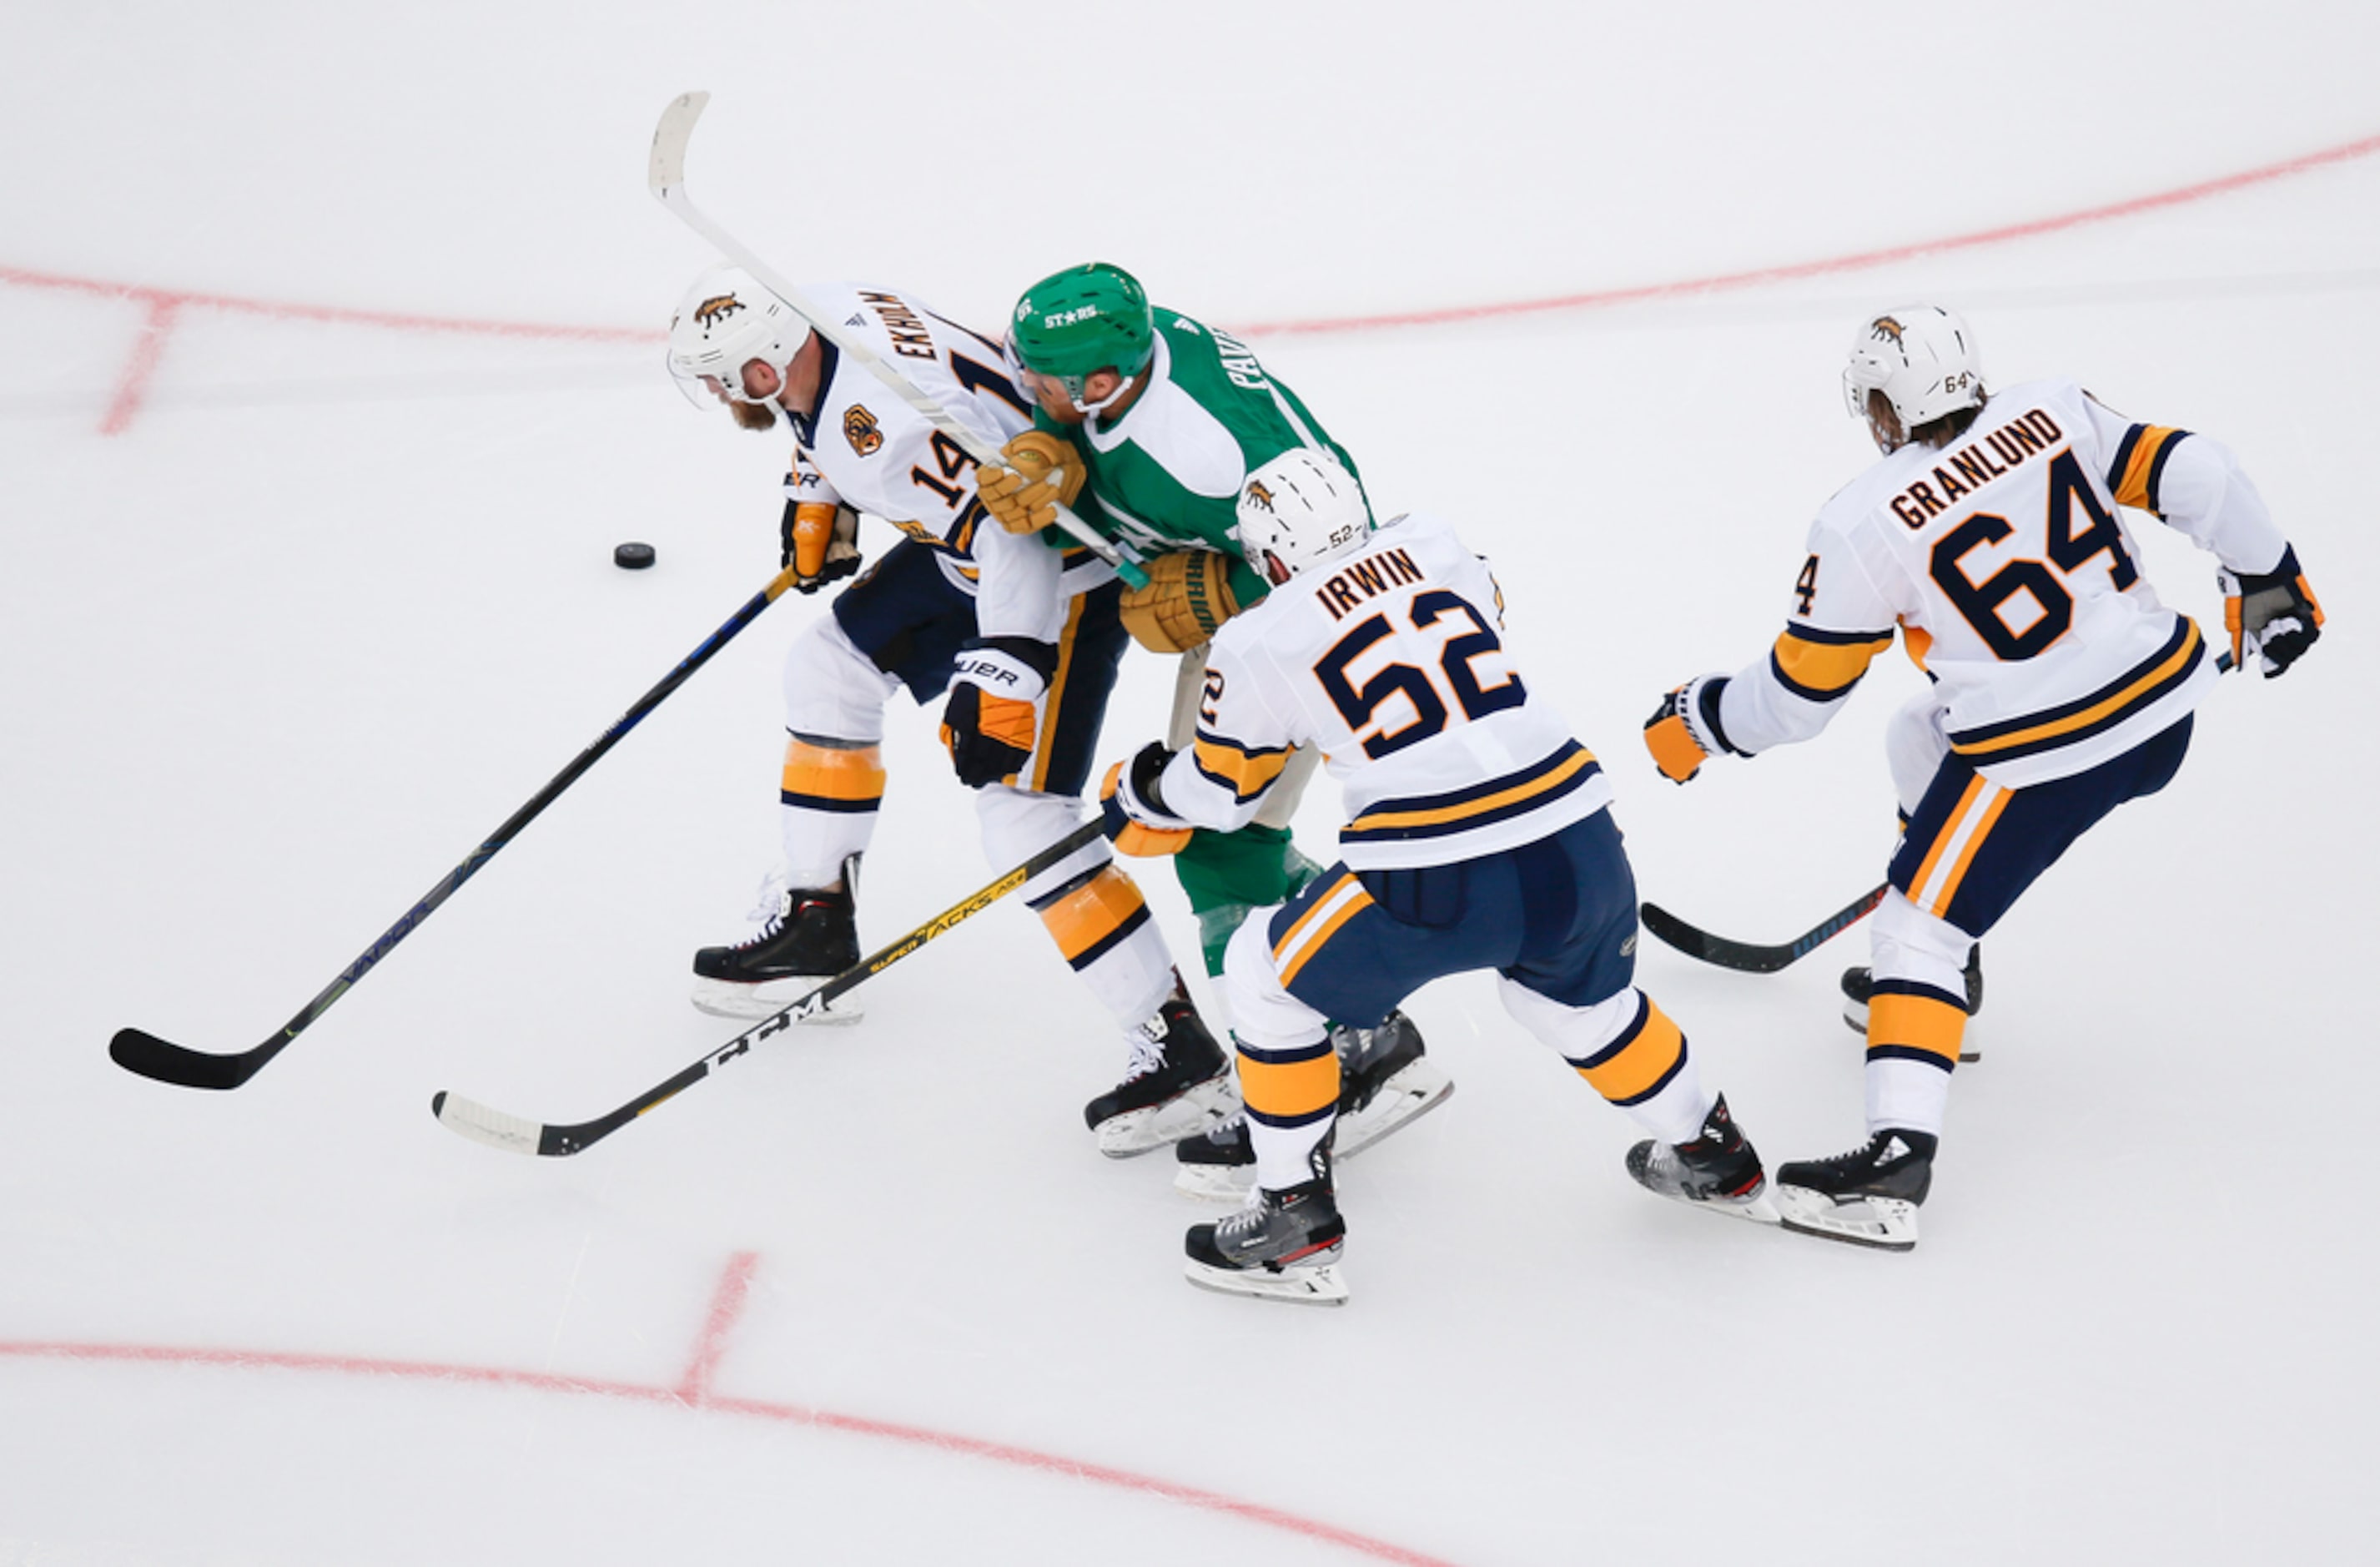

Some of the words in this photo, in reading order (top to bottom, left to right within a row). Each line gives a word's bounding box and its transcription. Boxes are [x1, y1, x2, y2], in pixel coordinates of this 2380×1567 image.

[1945, 372, 1967, 393] 64
[910, 428, 984, 510] 14
[1890, 407, 2064, 531] GRANLUND
[1329, 524, 1353, 548] 52
[1928, 445, 2141, 662] 64
[1315, 547, 1425, 621] IRWIN
[957, 660, 1019, 686] UER
[1312, 587, 1528, 761] 52
[704, 991, 826, 1079] CCM
